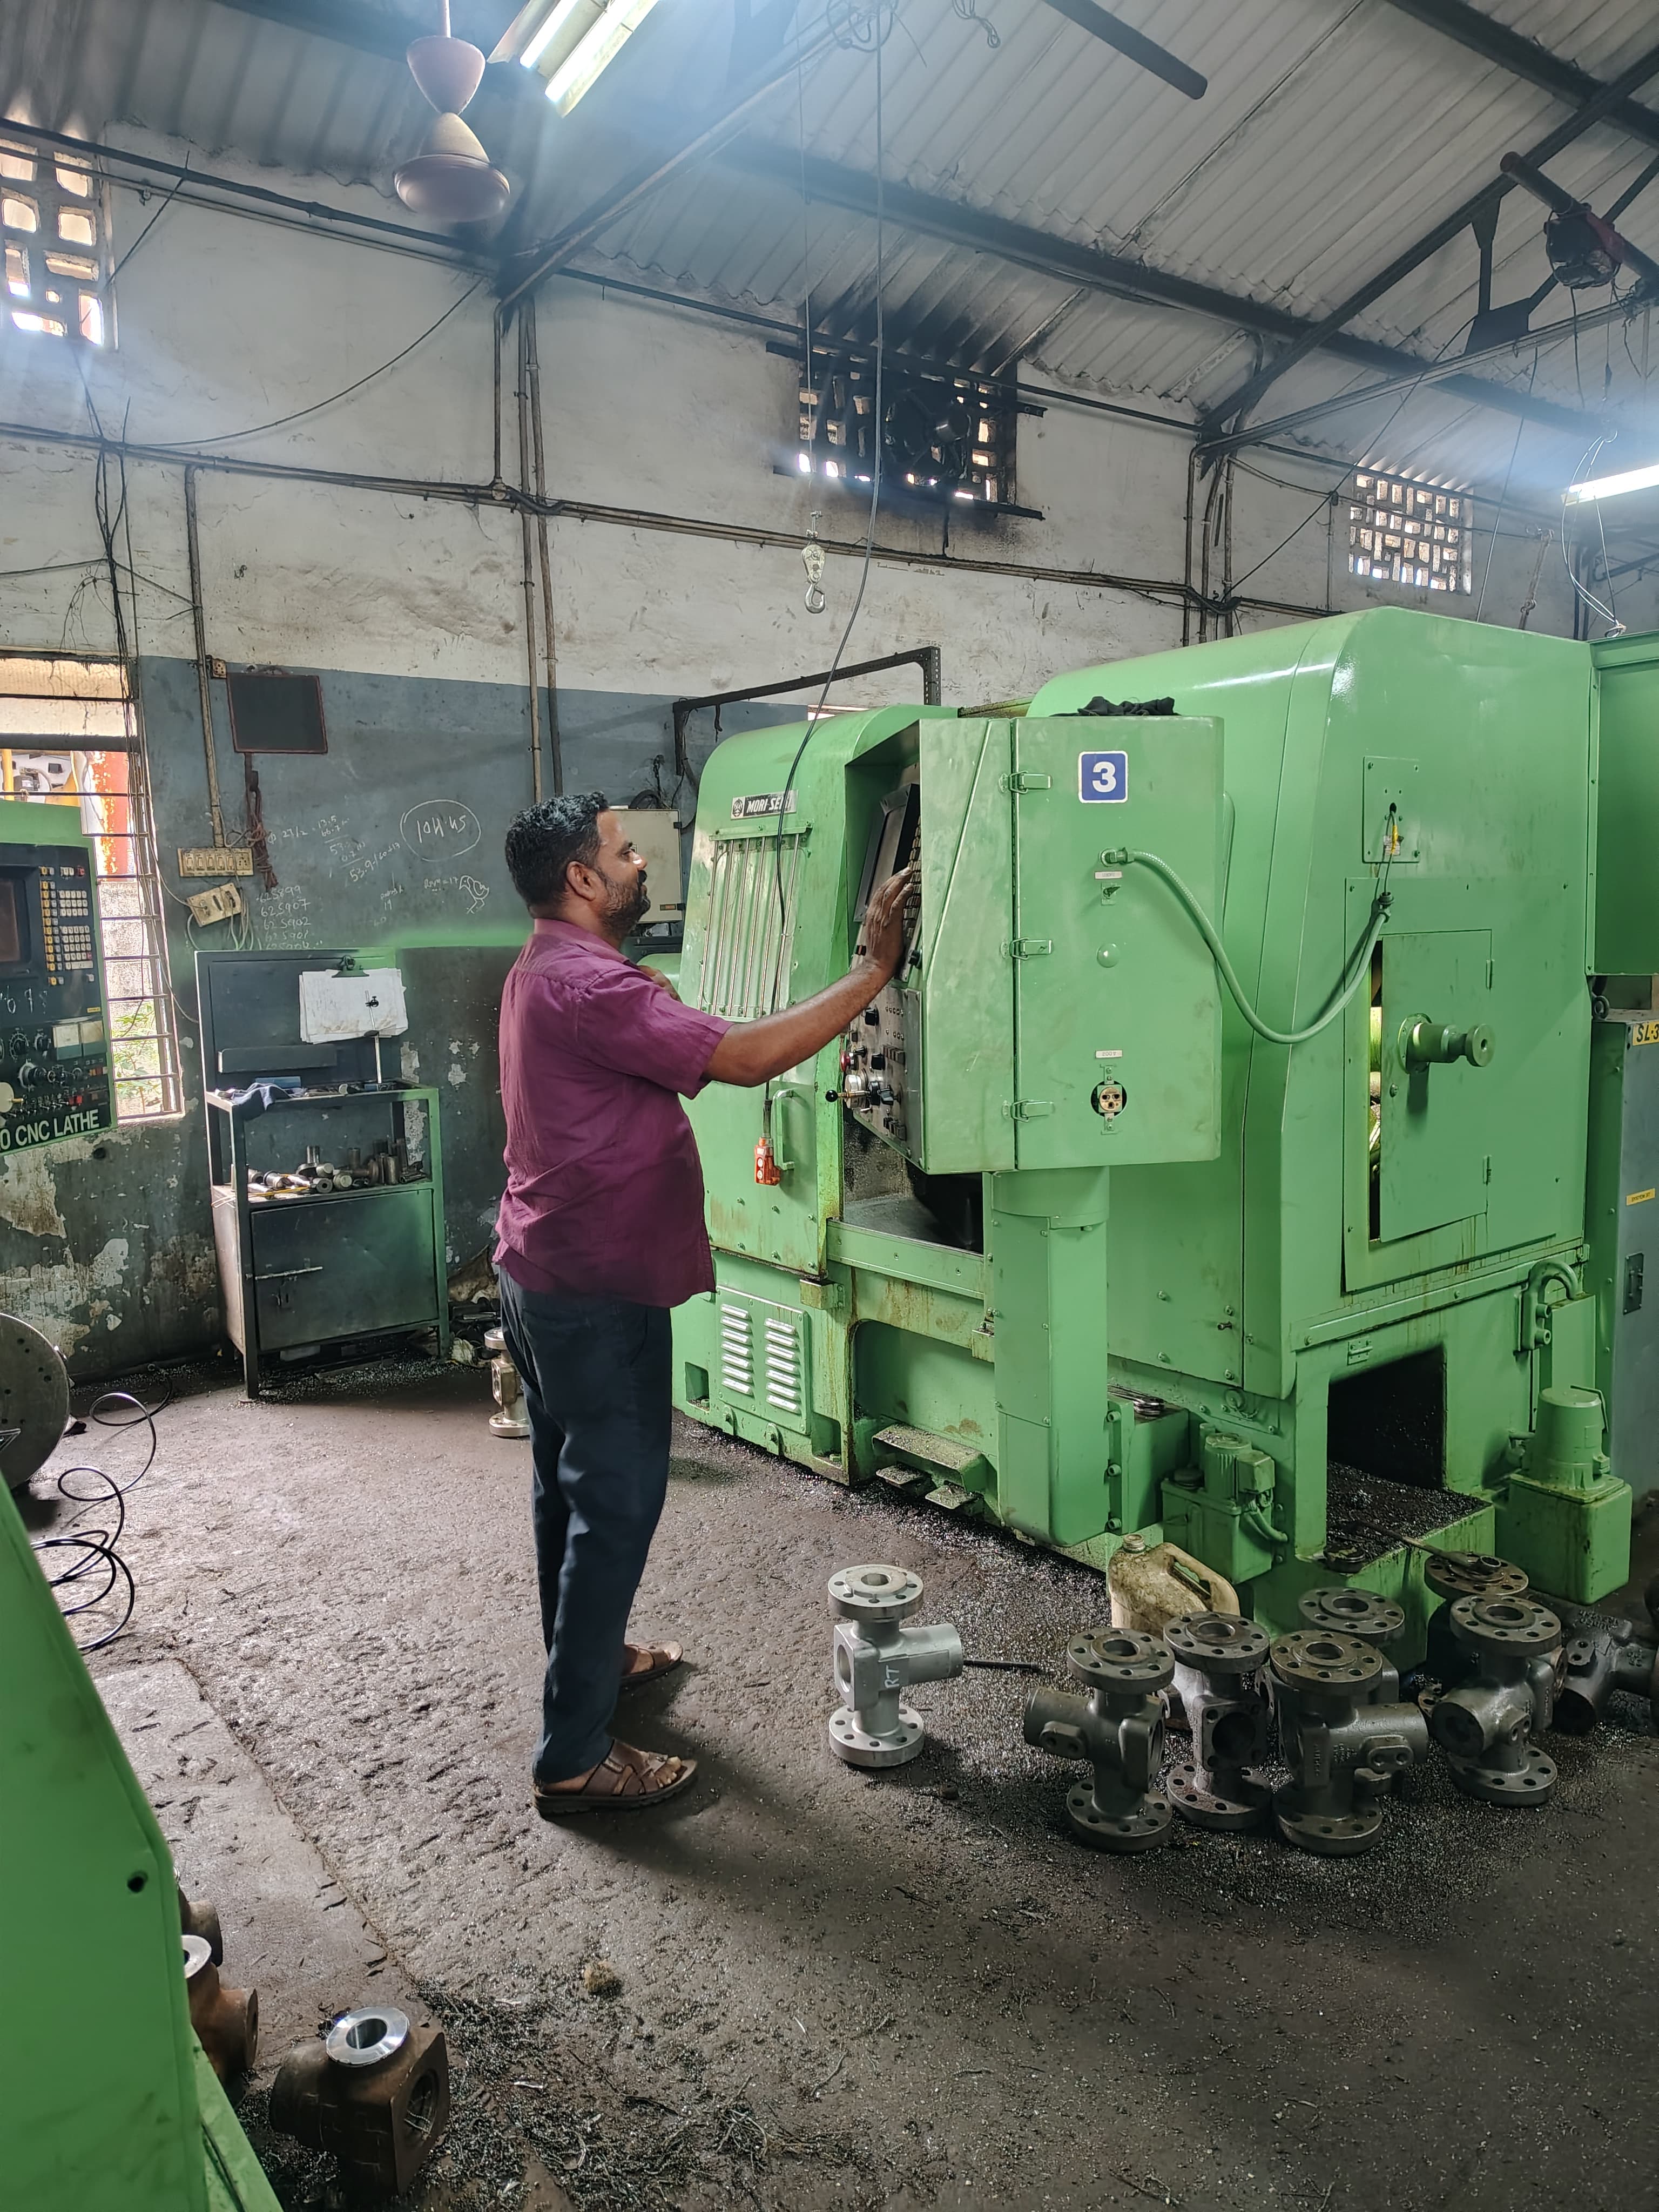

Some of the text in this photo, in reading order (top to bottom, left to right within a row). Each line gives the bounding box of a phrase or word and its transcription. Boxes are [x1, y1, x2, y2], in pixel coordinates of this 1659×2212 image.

[1092, 761, 1117, 793] 3
[15, 1120, 50, 1146] CNC
[53, 1109, 100, 1137] LATHE
[885, 1665, 900, 1688] RT
